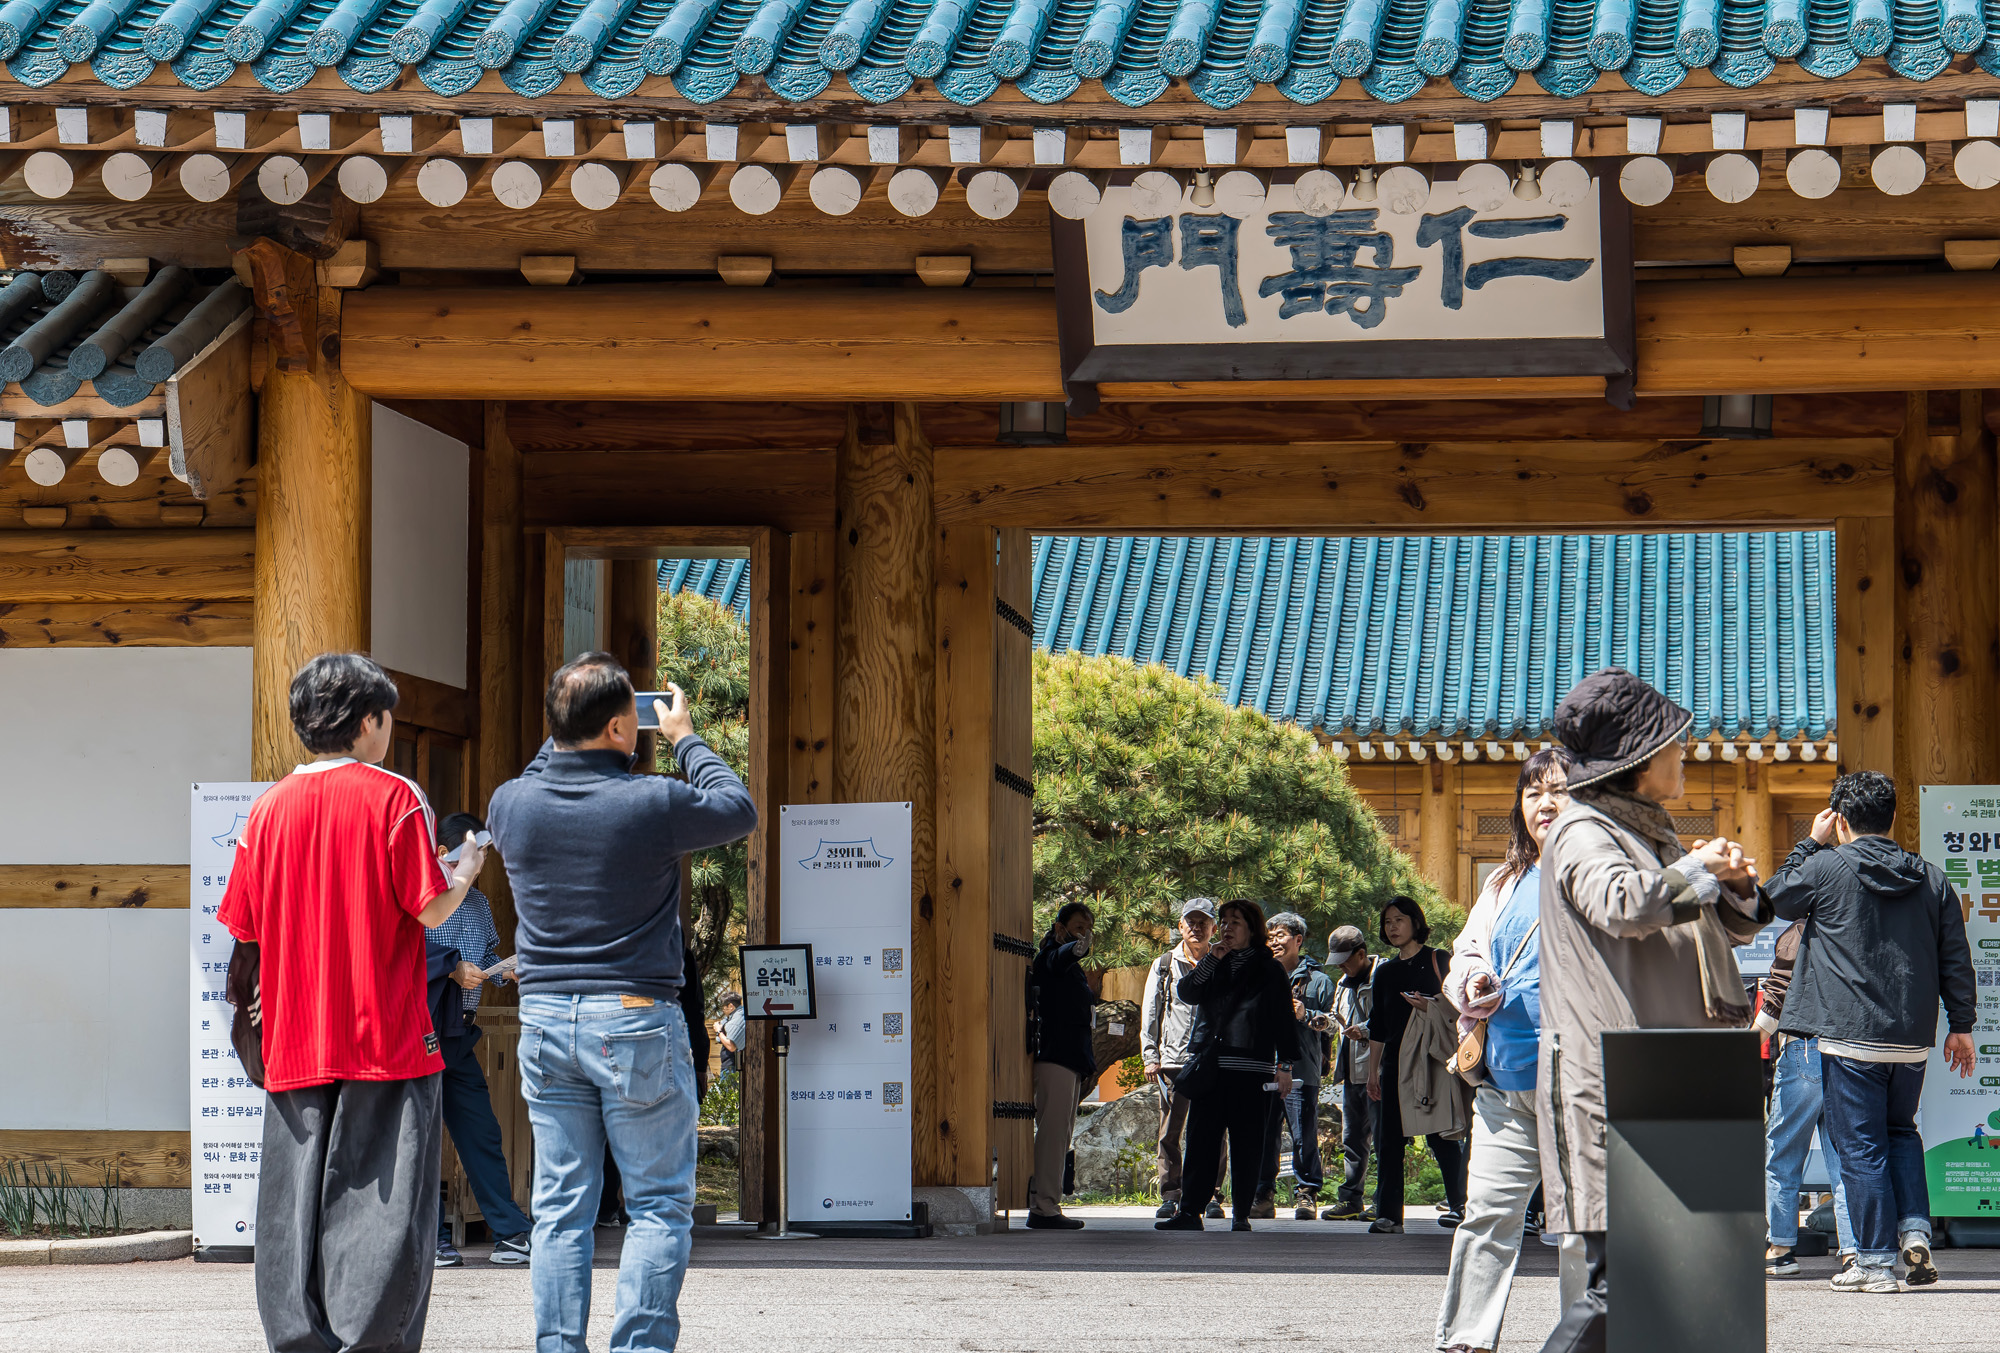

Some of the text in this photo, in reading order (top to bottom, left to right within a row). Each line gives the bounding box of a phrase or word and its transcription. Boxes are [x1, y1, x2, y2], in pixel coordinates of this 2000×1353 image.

[1970, 799, 1994, 808] 식목일
[1962, 810, 1978, 818] 수목
[1980, 809, 1996, 818] 관람
[202, 933, 211, 944] 관
[815, 955, 872, 966] 문화 공간 편
[202, 962, 211, 973] 구
[757, 967, 796, 987] 음수대
[201, 1020, 210, 1031] 본
[791, 1022, 871, 1033] 관 저 편
[201, 1049, 219, 1059] 본관
[201, 1078, 219, 1088] 본관
[790, 1089, 872, 1101] 청와대 소장 미술품 편
[201, 1106, 219, 1117] 본관
[227, 1106, 263, 1117] 집무실과
[203, 1152, 220, 1162] 역사
[229, 1152, 247, 1162] 문화
[204, 1183, 232, 1194] 본관 편
